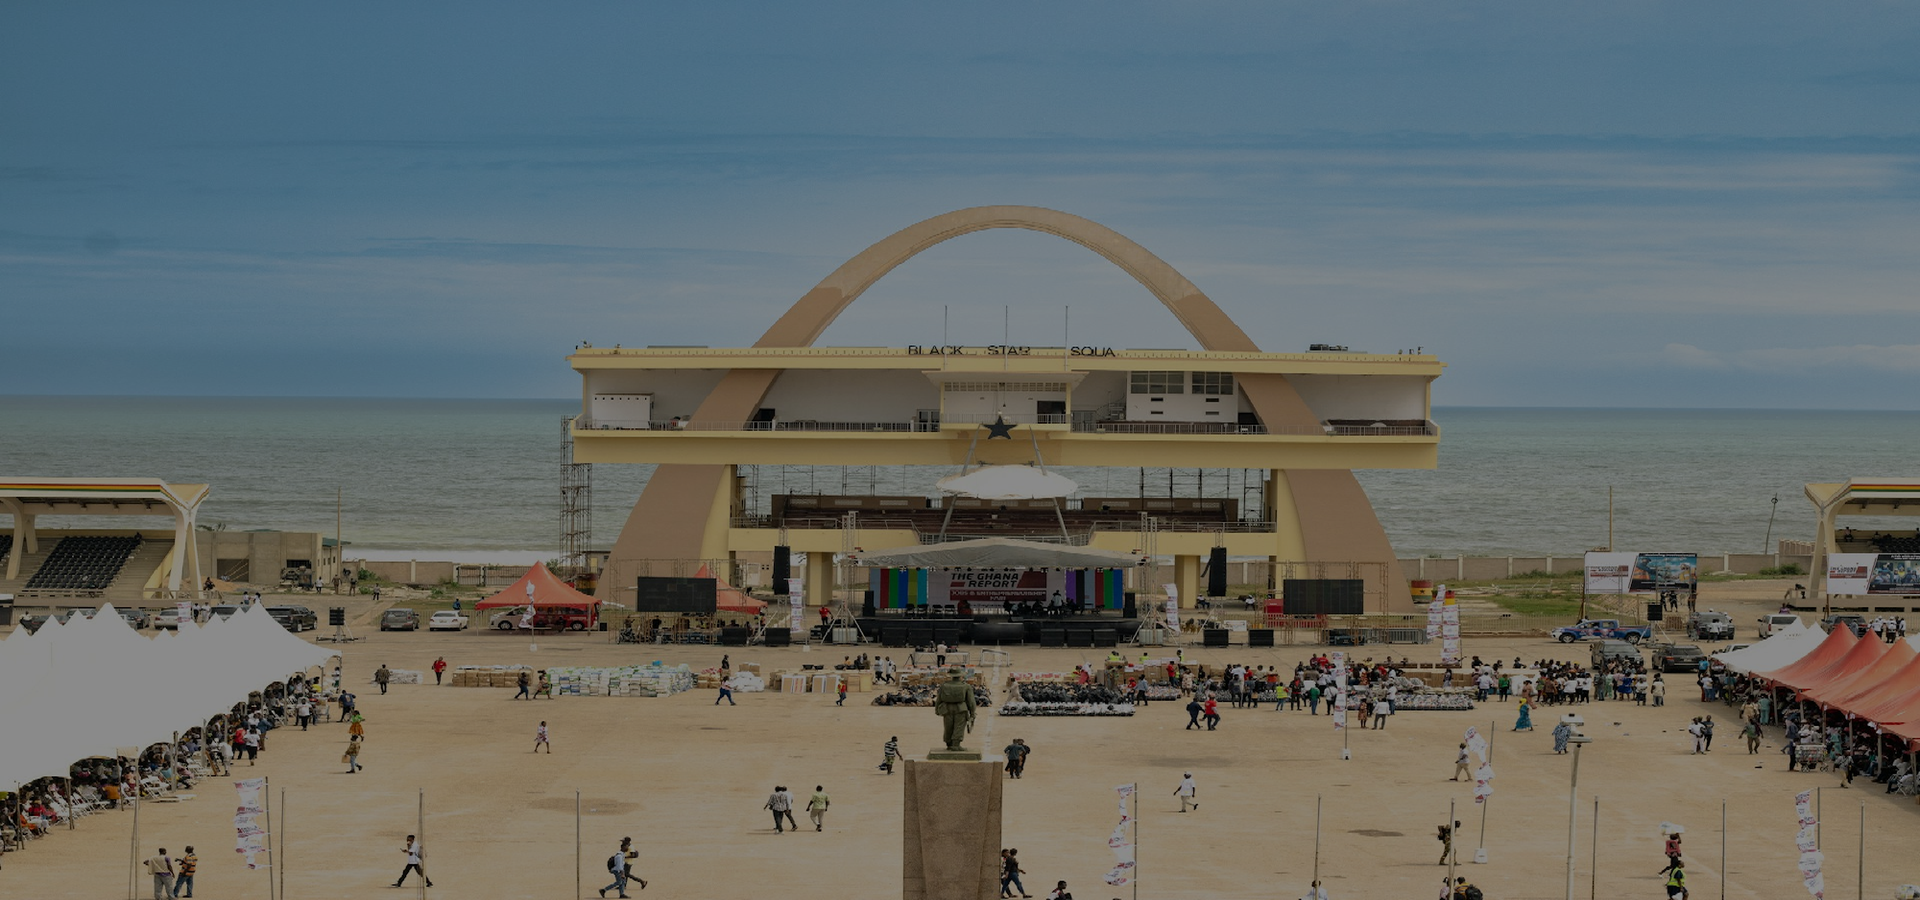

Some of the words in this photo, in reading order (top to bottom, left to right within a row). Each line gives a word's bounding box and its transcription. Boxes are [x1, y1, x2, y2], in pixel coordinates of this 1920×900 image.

[908, 345, 964, 355] BLACK
[1070, 346, 1116, 357] SQUA
[968, 580, 1017, 588] REPORT
